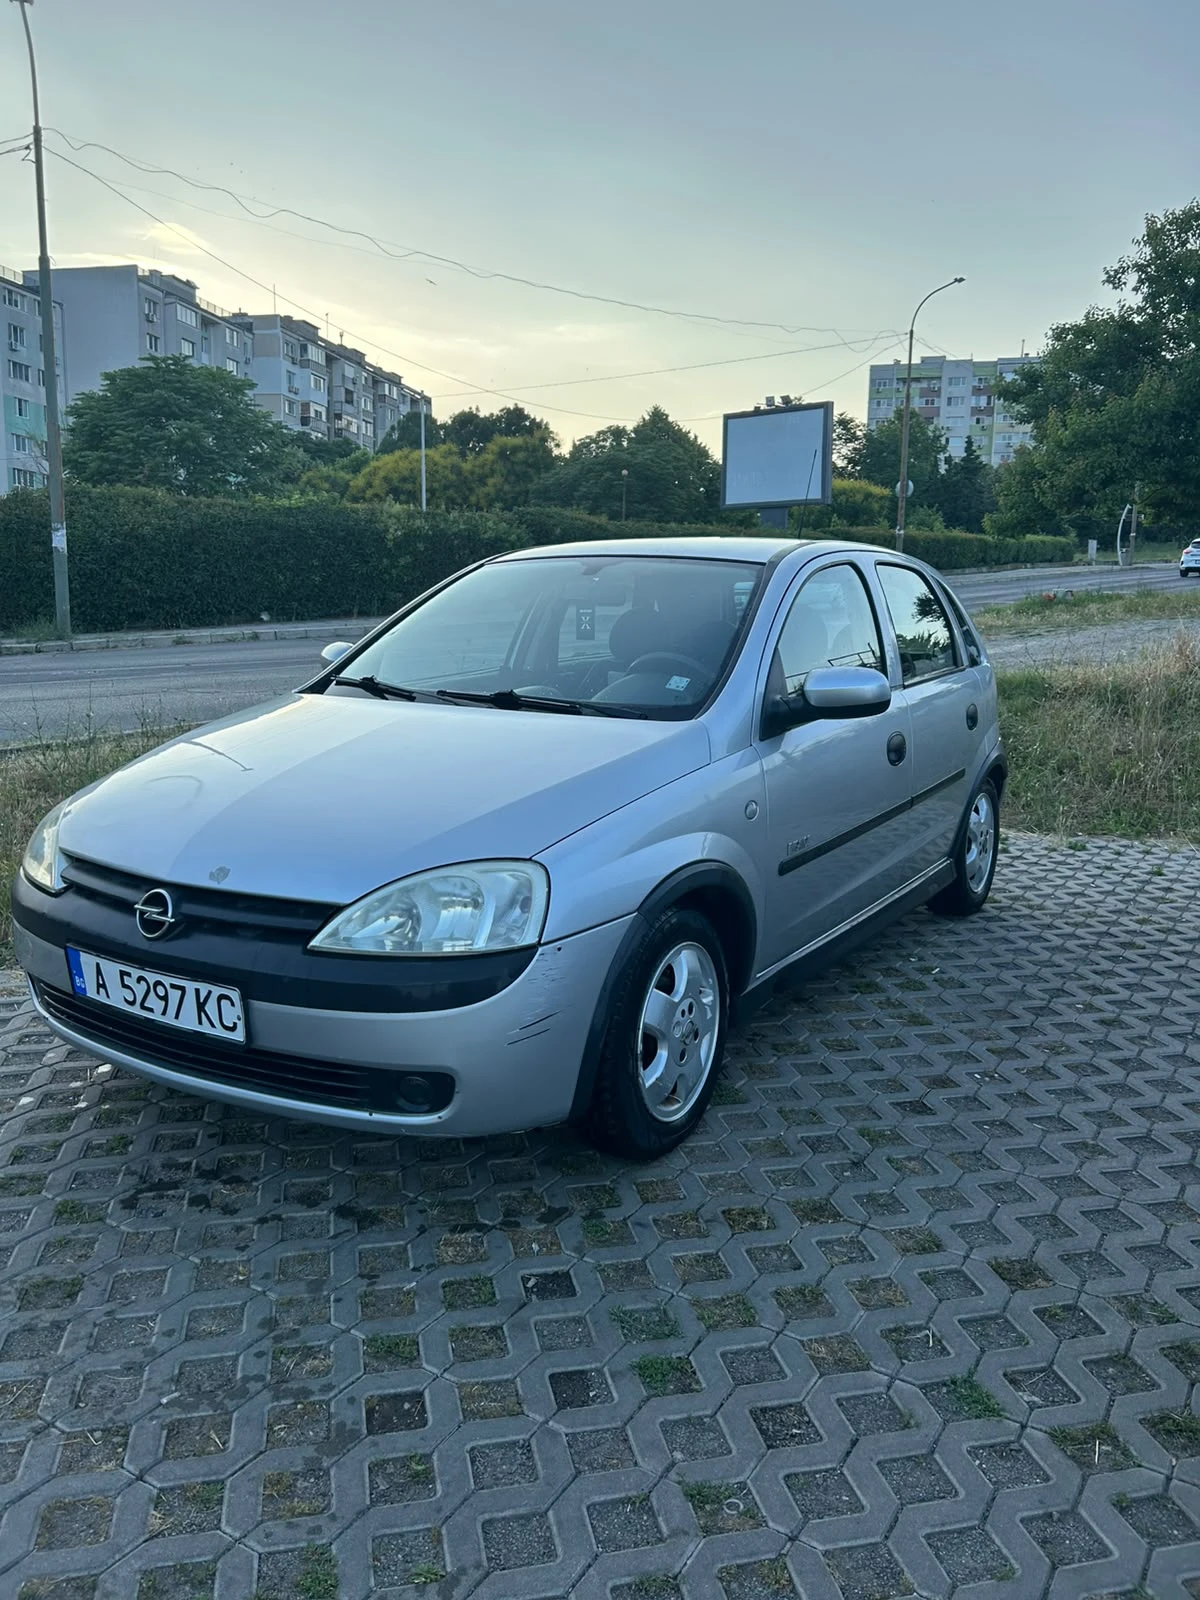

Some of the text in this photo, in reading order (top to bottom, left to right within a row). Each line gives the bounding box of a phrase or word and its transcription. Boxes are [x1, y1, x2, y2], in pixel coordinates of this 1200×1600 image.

[75, 975, 85, 989] BG
[96, 962, 238, 1032] A 5297 KC
